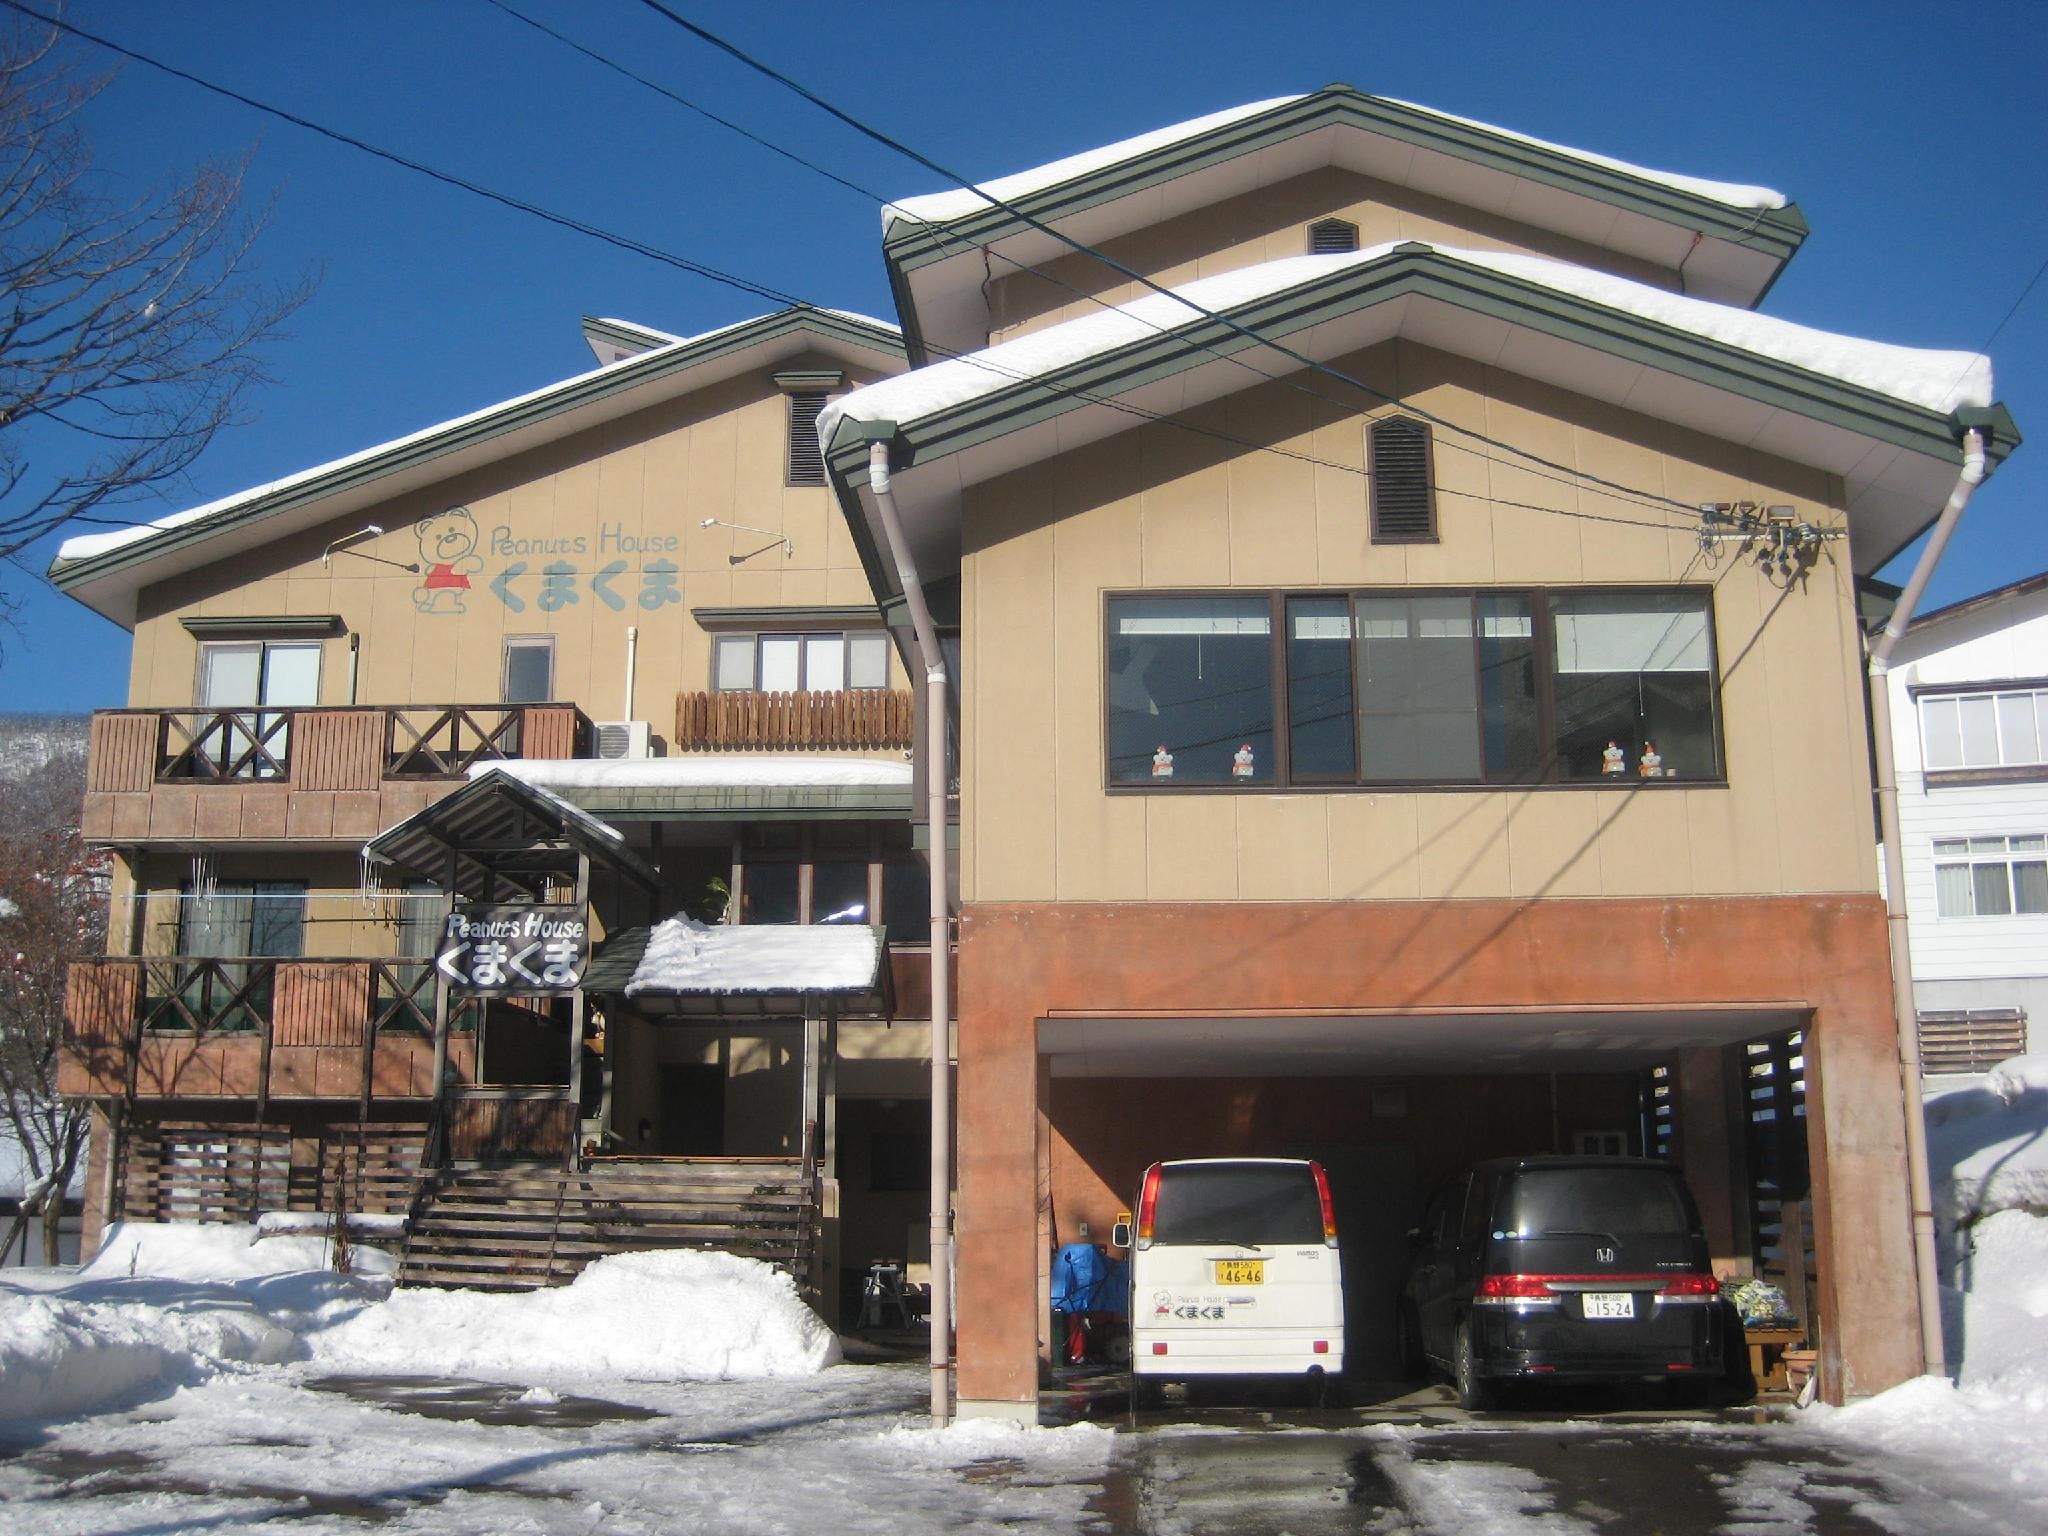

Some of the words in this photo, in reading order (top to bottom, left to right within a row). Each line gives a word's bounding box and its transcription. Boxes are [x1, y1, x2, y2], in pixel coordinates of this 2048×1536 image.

[490, 526, 586, 556] Peanuts
[600, 522, 679, 553] House
[489, 558, 682, 613] くまくま
[447, 913, 520, 938] Peanuts
[524, 912, 584, 938] House
[437, 939, 579, 985] くまくま
[1226, 1270, 1261, 1282] 46-46
[1174, 1305, 1225, 1319] くまくま
[1596, 1302, 1631, 1316] 15-24
